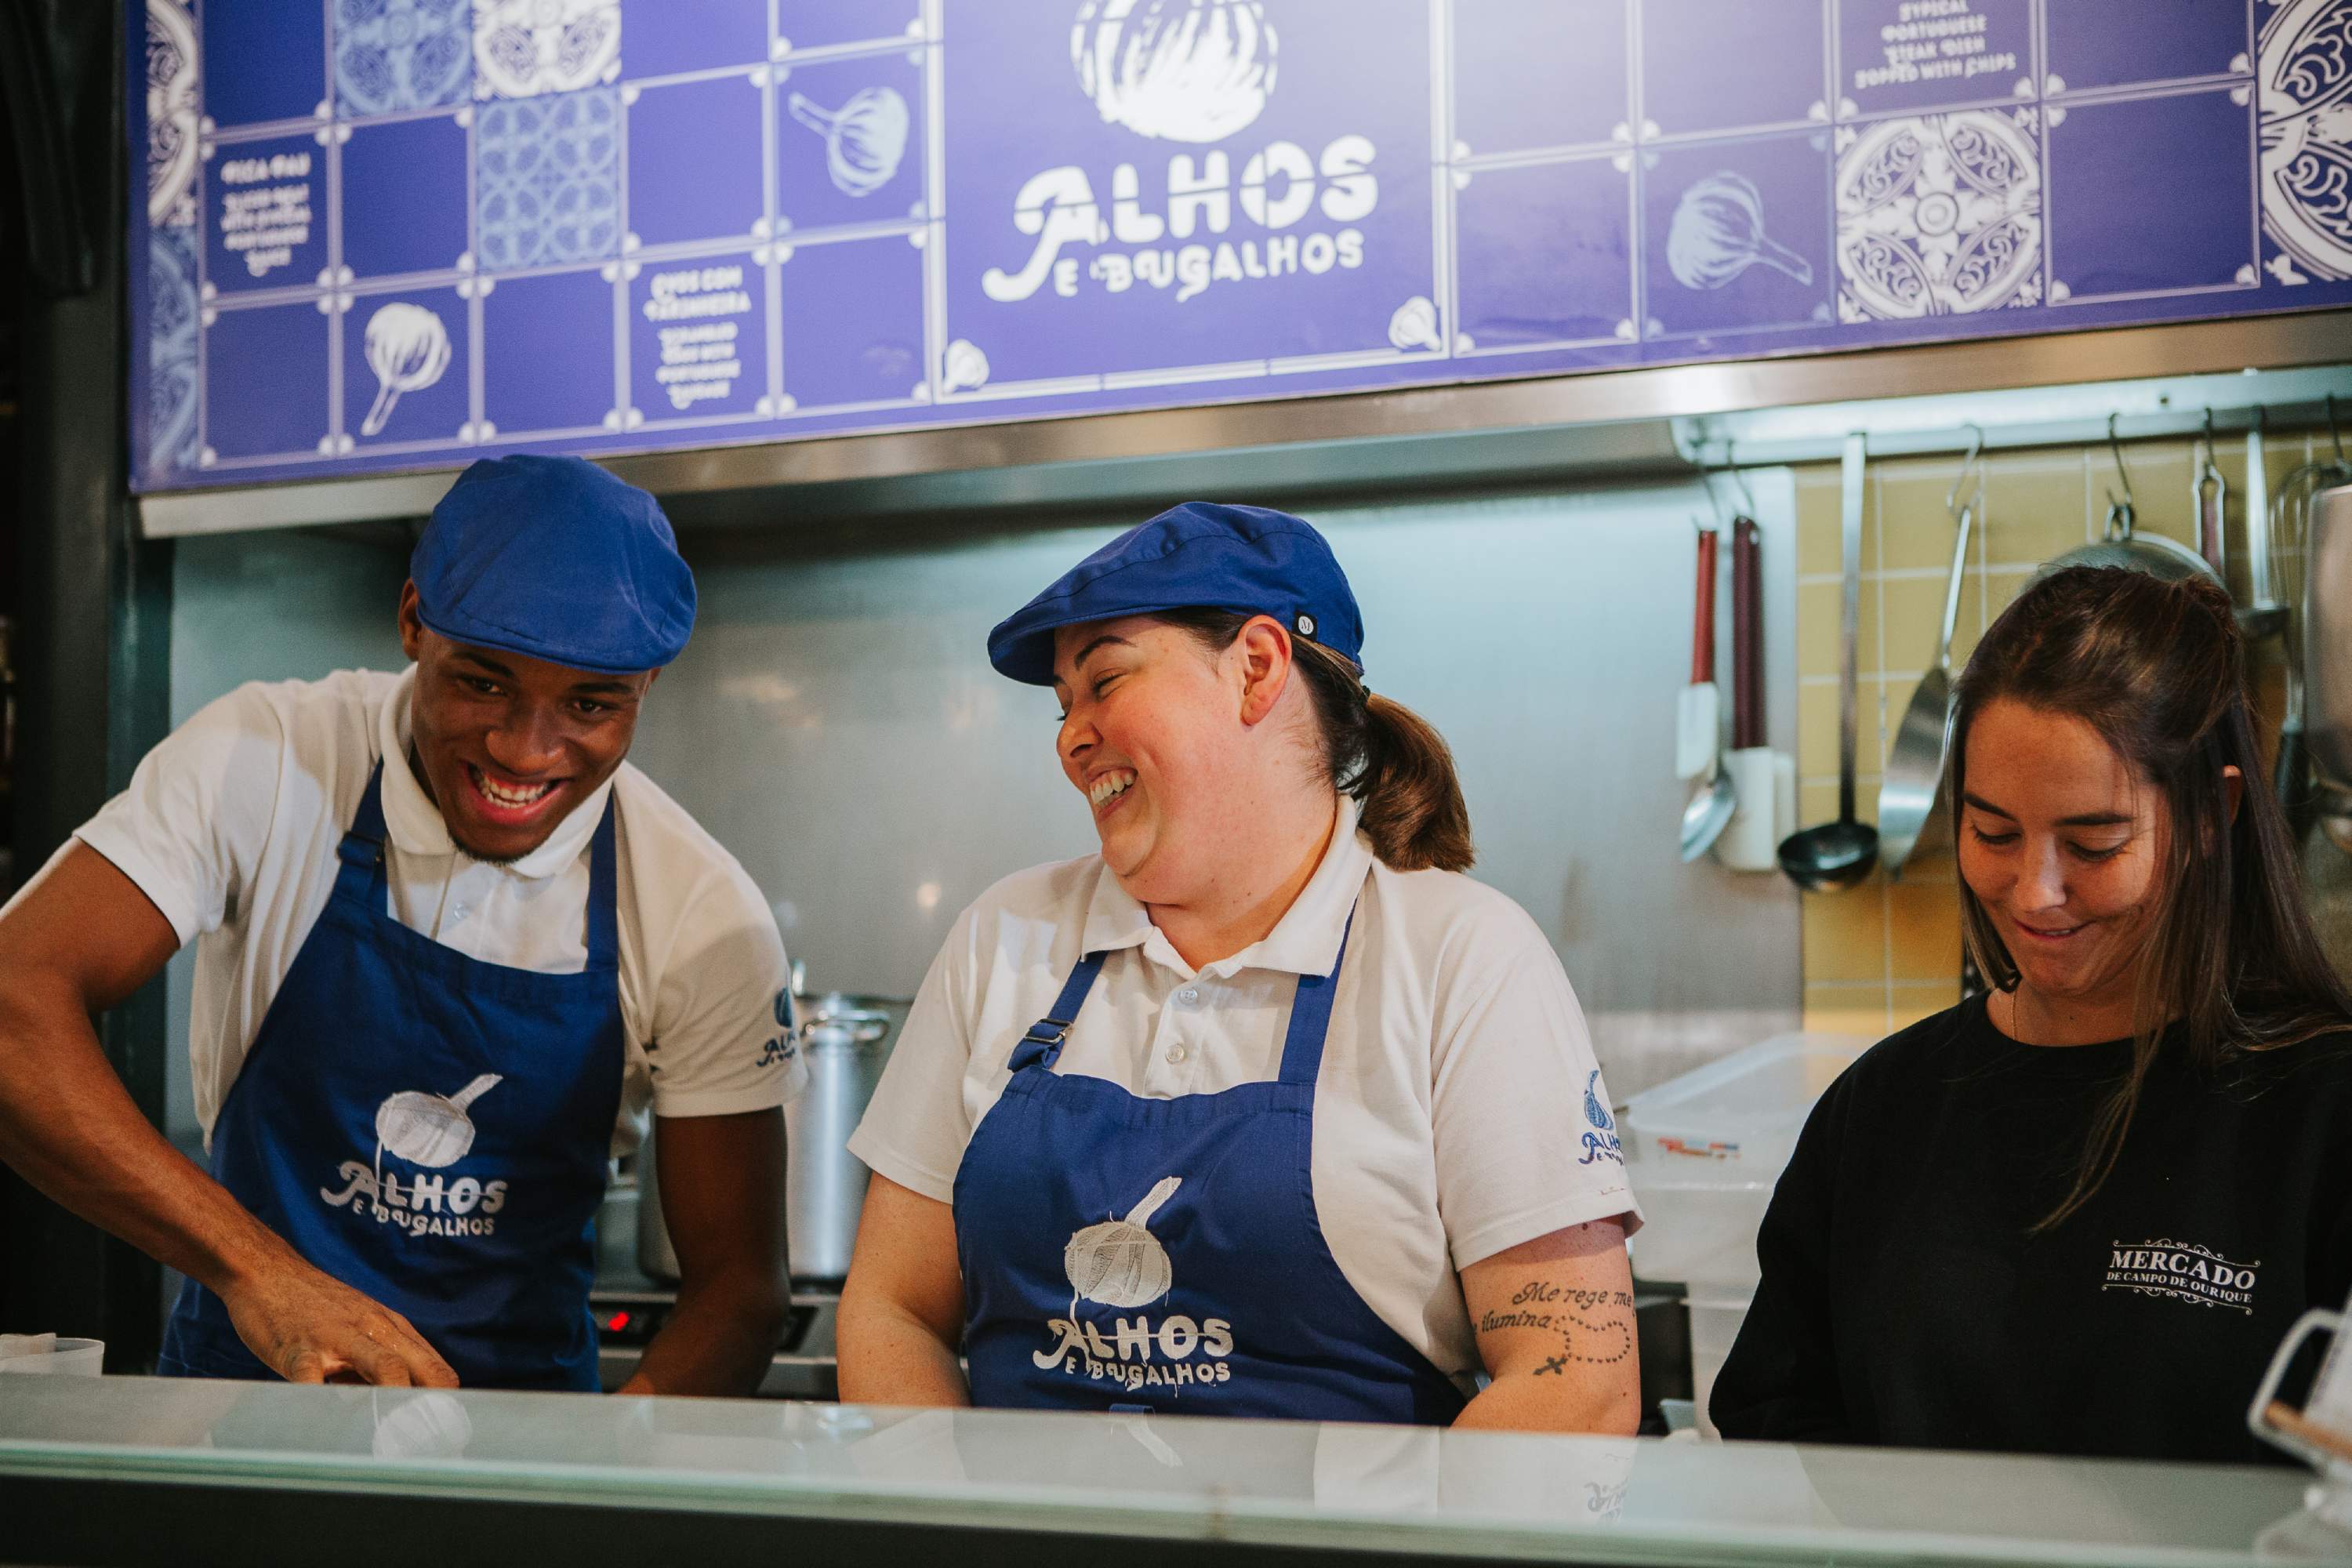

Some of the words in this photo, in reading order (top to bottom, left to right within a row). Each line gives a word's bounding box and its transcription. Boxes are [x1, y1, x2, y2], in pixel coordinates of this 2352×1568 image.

[1880, 13, 1987, 42] PORTUGUESE
[1883, 41, 1938, 66] STEAK
[1940, 35, 1986, 56] DISH
[1855, 61, 1919, 89] TOPPED
[1920, 58, 1963, 79] WITH
[1964, 52, 2016, 78] CHIPS
[981, 133, 1379, 303] ALHOS
[1053, 258, 1080, 298] E
[1089, 227, 1366, 303] BUGALHOS
[320, 1160, 508, 1214] ALHOS
[353, 1198, 364, 1214] E
[371, 1203, 495, 1237] BUGALHOS
[2107, 1272, 2121, 1281] DE
[2123, 1272, 2168, 1283] CAMPO
[2169, 1276, 2188, 1288] DE
[2190, 1281, 2252, 1303] OURIQUE
[2109, 1250, 2256, 1290] MERCADO
[1033, 1316, 1234, 1370] ALHOS
[1065, 1356, 1076, 1374] E
[1086, 1360, 1231, 1392] BUGALHOS
